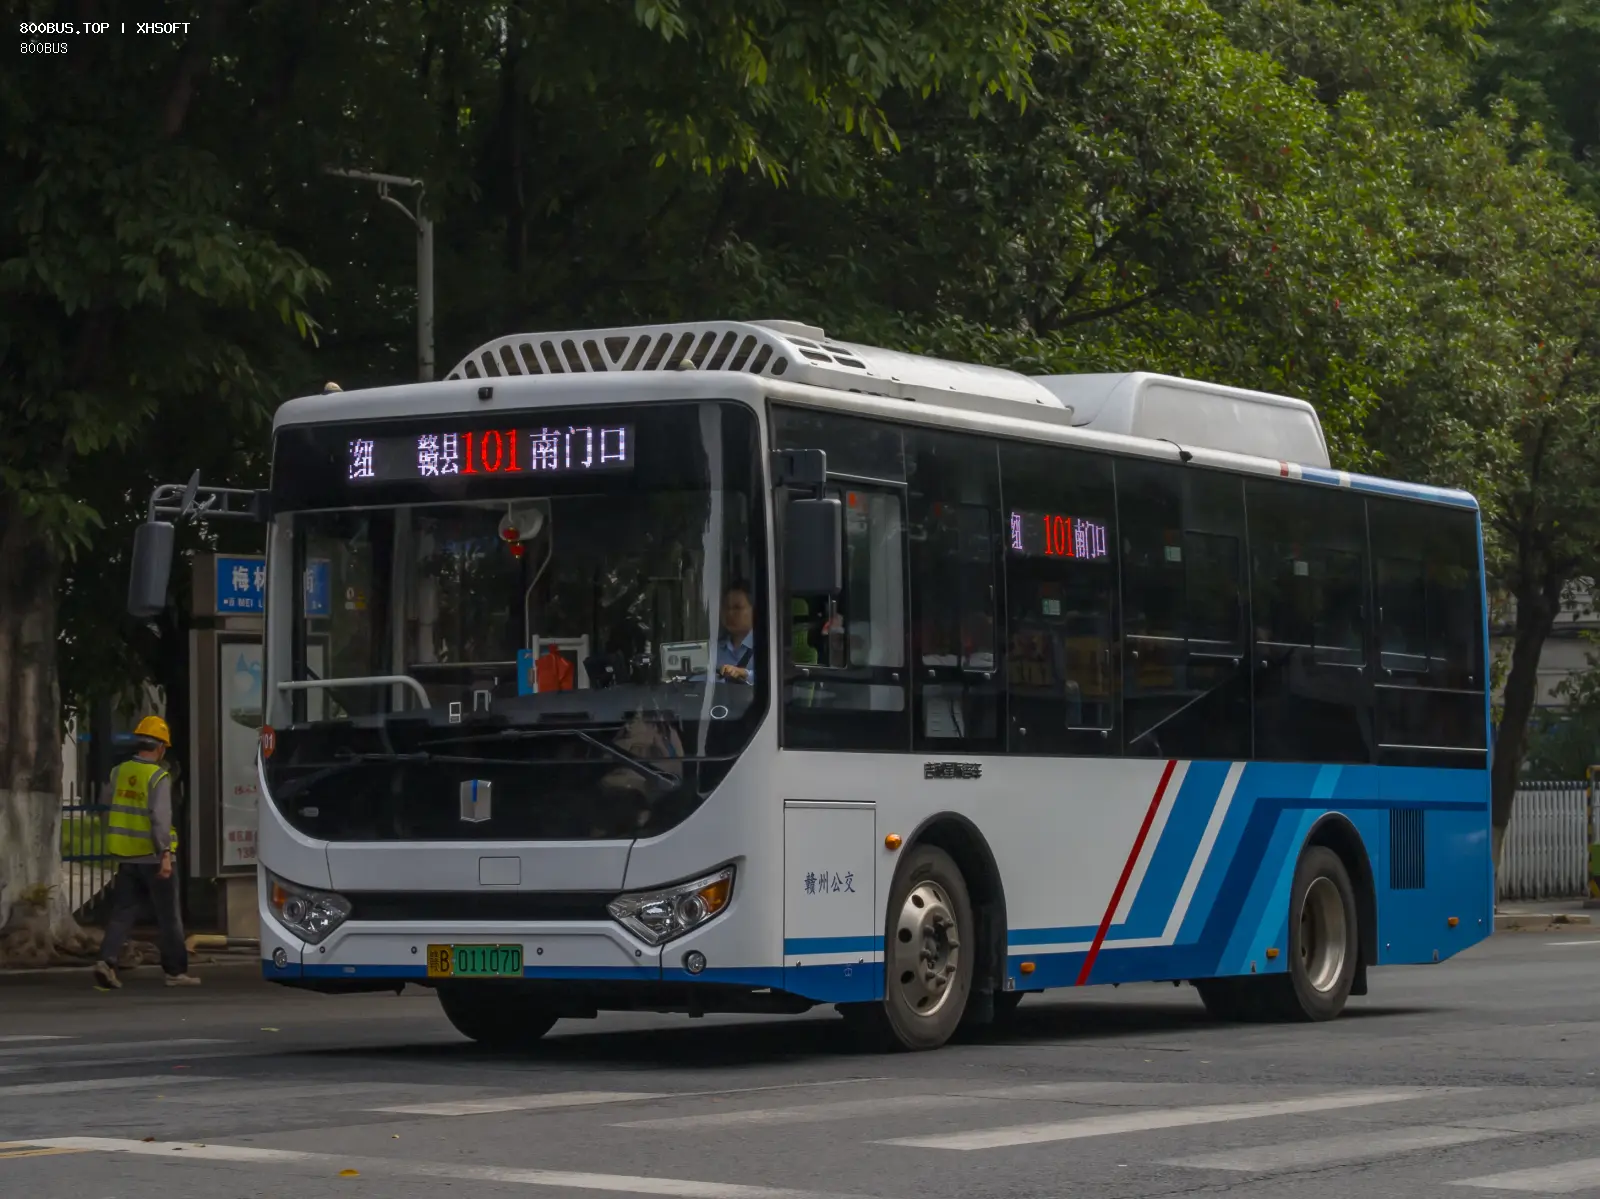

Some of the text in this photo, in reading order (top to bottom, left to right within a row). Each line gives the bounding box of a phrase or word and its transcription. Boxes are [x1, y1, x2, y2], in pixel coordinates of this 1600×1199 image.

[460, 428, 523, 476] 101
[529, 426, 627, 471] 南门口
[1044, 514, 1075, 557] 101
[1074, 518, 1106, 559] 南门口
[803, 869, 857, 896] 赣州公交
